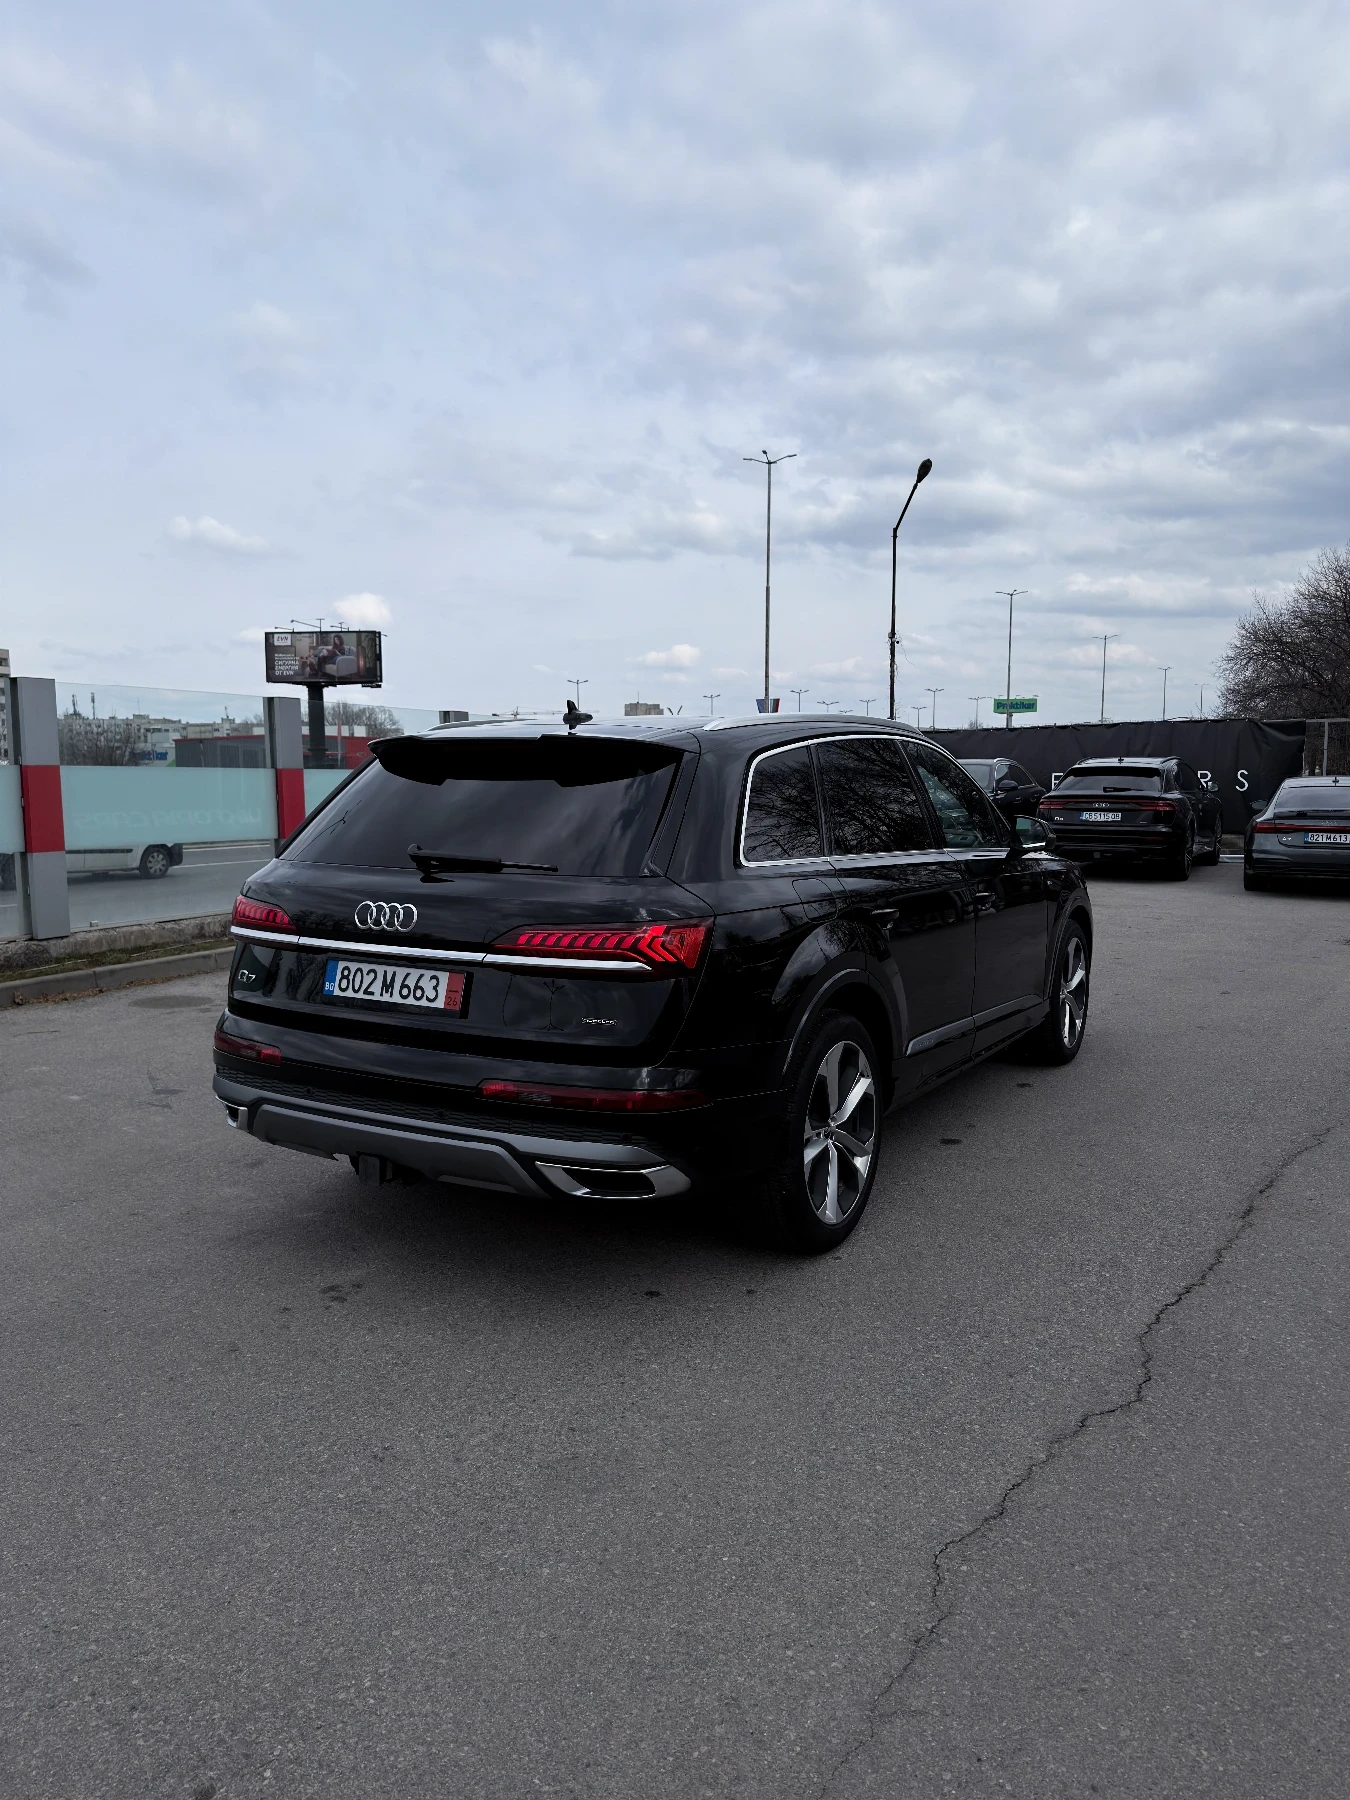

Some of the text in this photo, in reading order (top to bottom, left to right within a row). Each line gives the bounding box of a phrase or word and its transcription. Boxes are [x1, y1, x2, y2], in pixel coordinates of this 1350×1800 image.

[238, 969, 256, 984] Q7
[324, 981, 335, 991] BG
[446, 996, 458, 1006] 26
